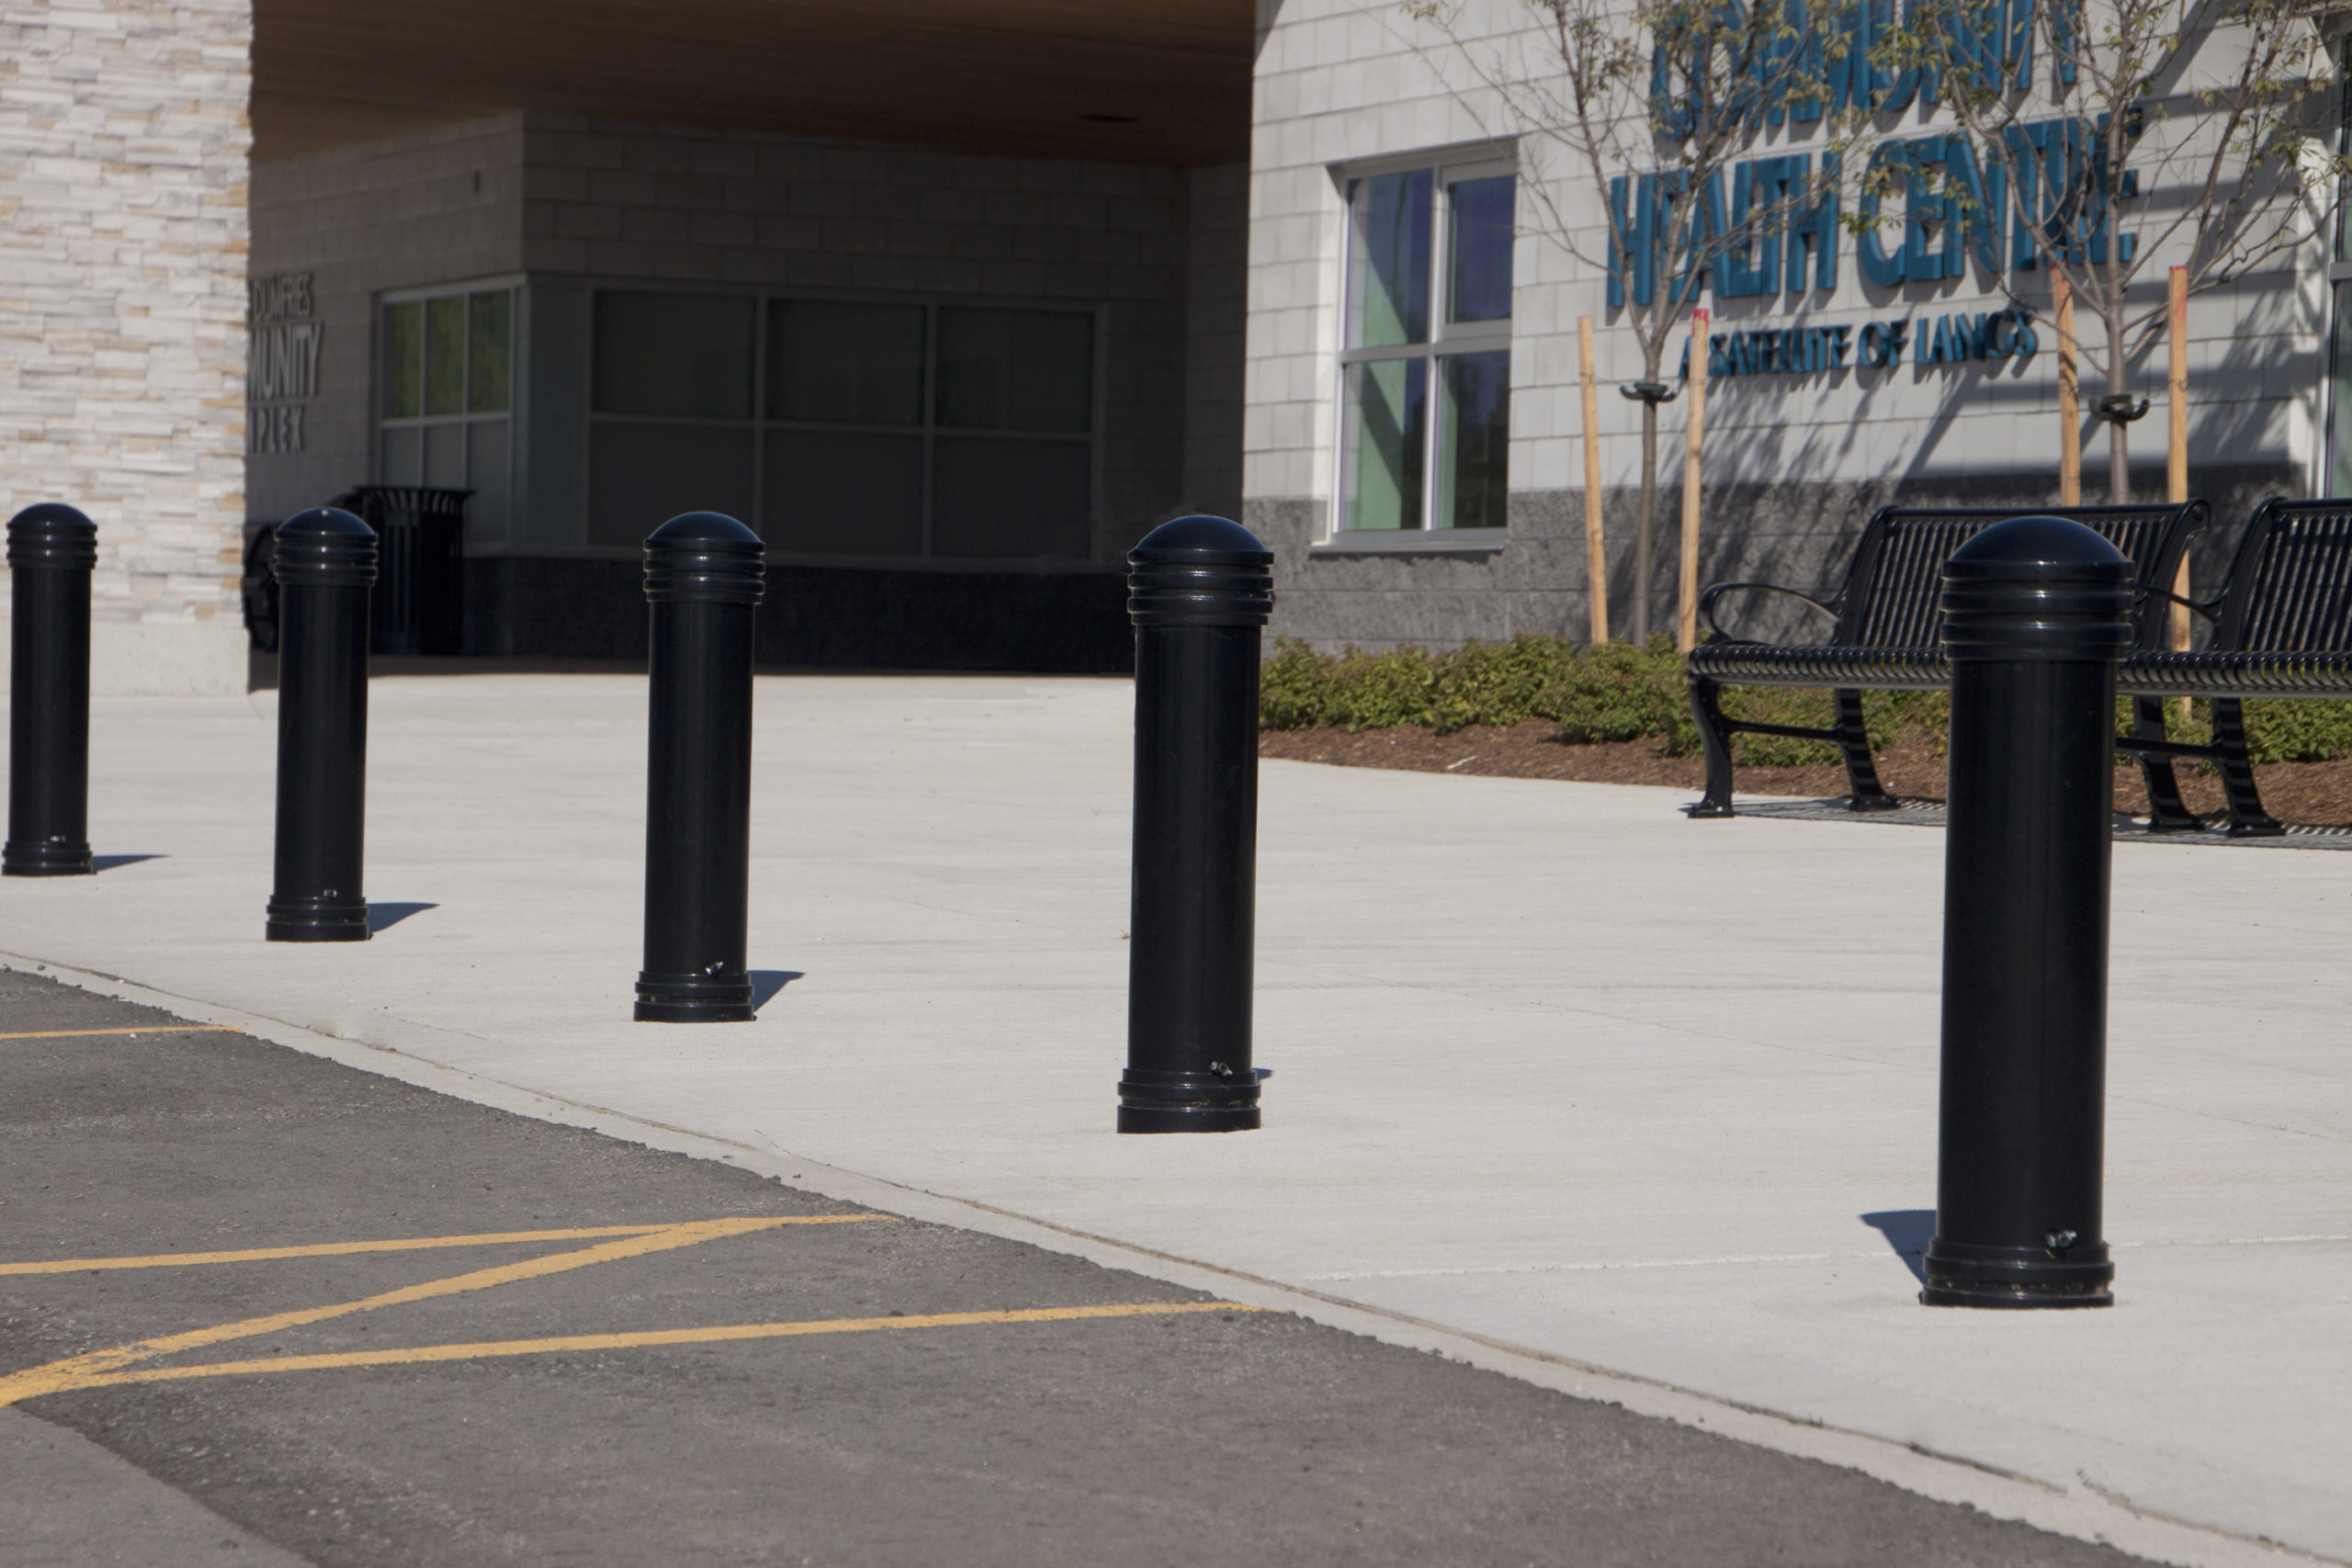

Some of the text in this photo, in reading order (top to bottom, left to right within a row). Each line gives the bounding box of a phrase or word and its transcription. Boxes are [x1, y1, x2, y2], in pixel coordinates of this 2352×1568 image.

[1607, 108, 2142, 307] HEALTH CENTRE
[1858, 318, 1910, 368] OF
